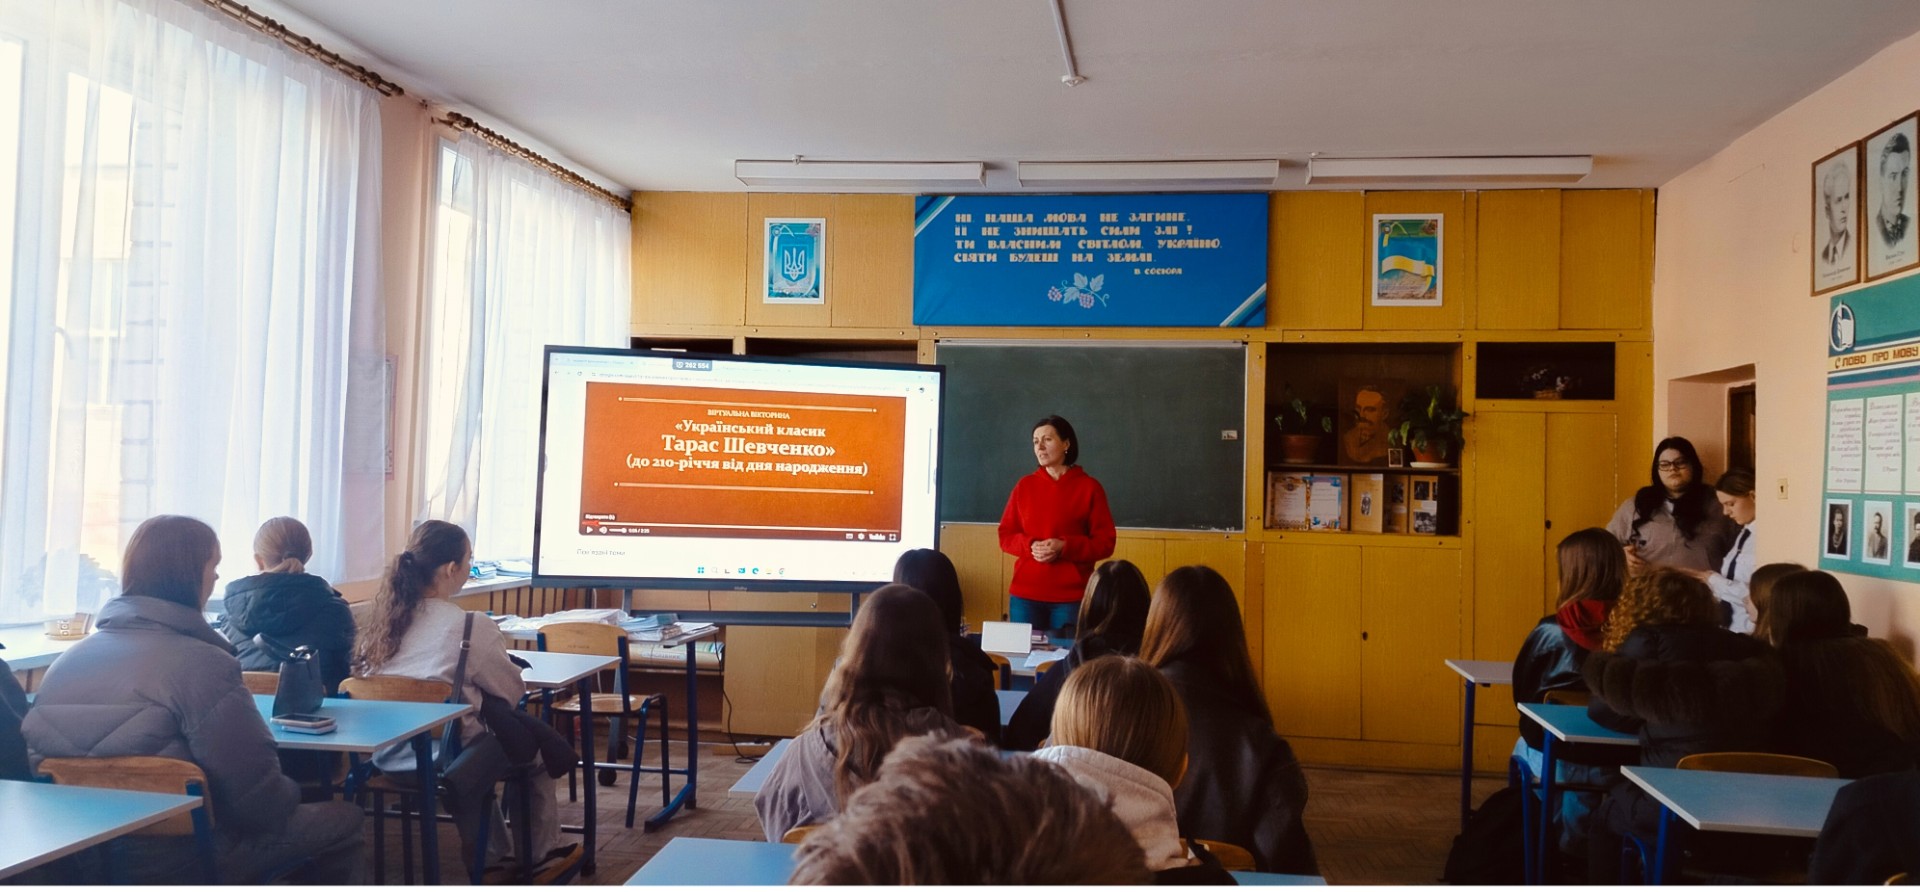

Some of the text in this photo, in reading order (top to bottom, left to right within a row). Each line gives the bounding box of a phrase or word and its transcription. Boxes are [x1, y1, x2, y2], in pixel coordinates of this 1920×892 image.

[985, 213, 1034, 223] НАША
[1044, 212, 1087, 223] МОВА
[1100, 212, 1118, 222] НЕ
[954, 225, 967, 236] ЇЇ
[981, 226, 1000, 236] НЕ
[1013, 226, 1088, 236] ЗНИЩАТЬ
[1100, 225, 1140, 236] СИЛИ
[955, 240, 975, 249] ТИ
[988, 239, 1061, 249] ВЛАСНИМ
[953, 253, 997, 263] СІЯТИ
[1009, 253, 1059, 263] БУДЕШ
[1071, 253, 1094, 263] НА
[1834, 346, 1919, 369] СЛОВО ПРО МОВУ
[707, 409, 791, 419] ВІРТУАЛЬНА ВІКТОРИНА
[674, 419, 826, 437] «Український класик
[661, 434, 836, 457] Тарас Шевченко»
[626, 453, 869, 477] (до 210-річчя від дня народження)
